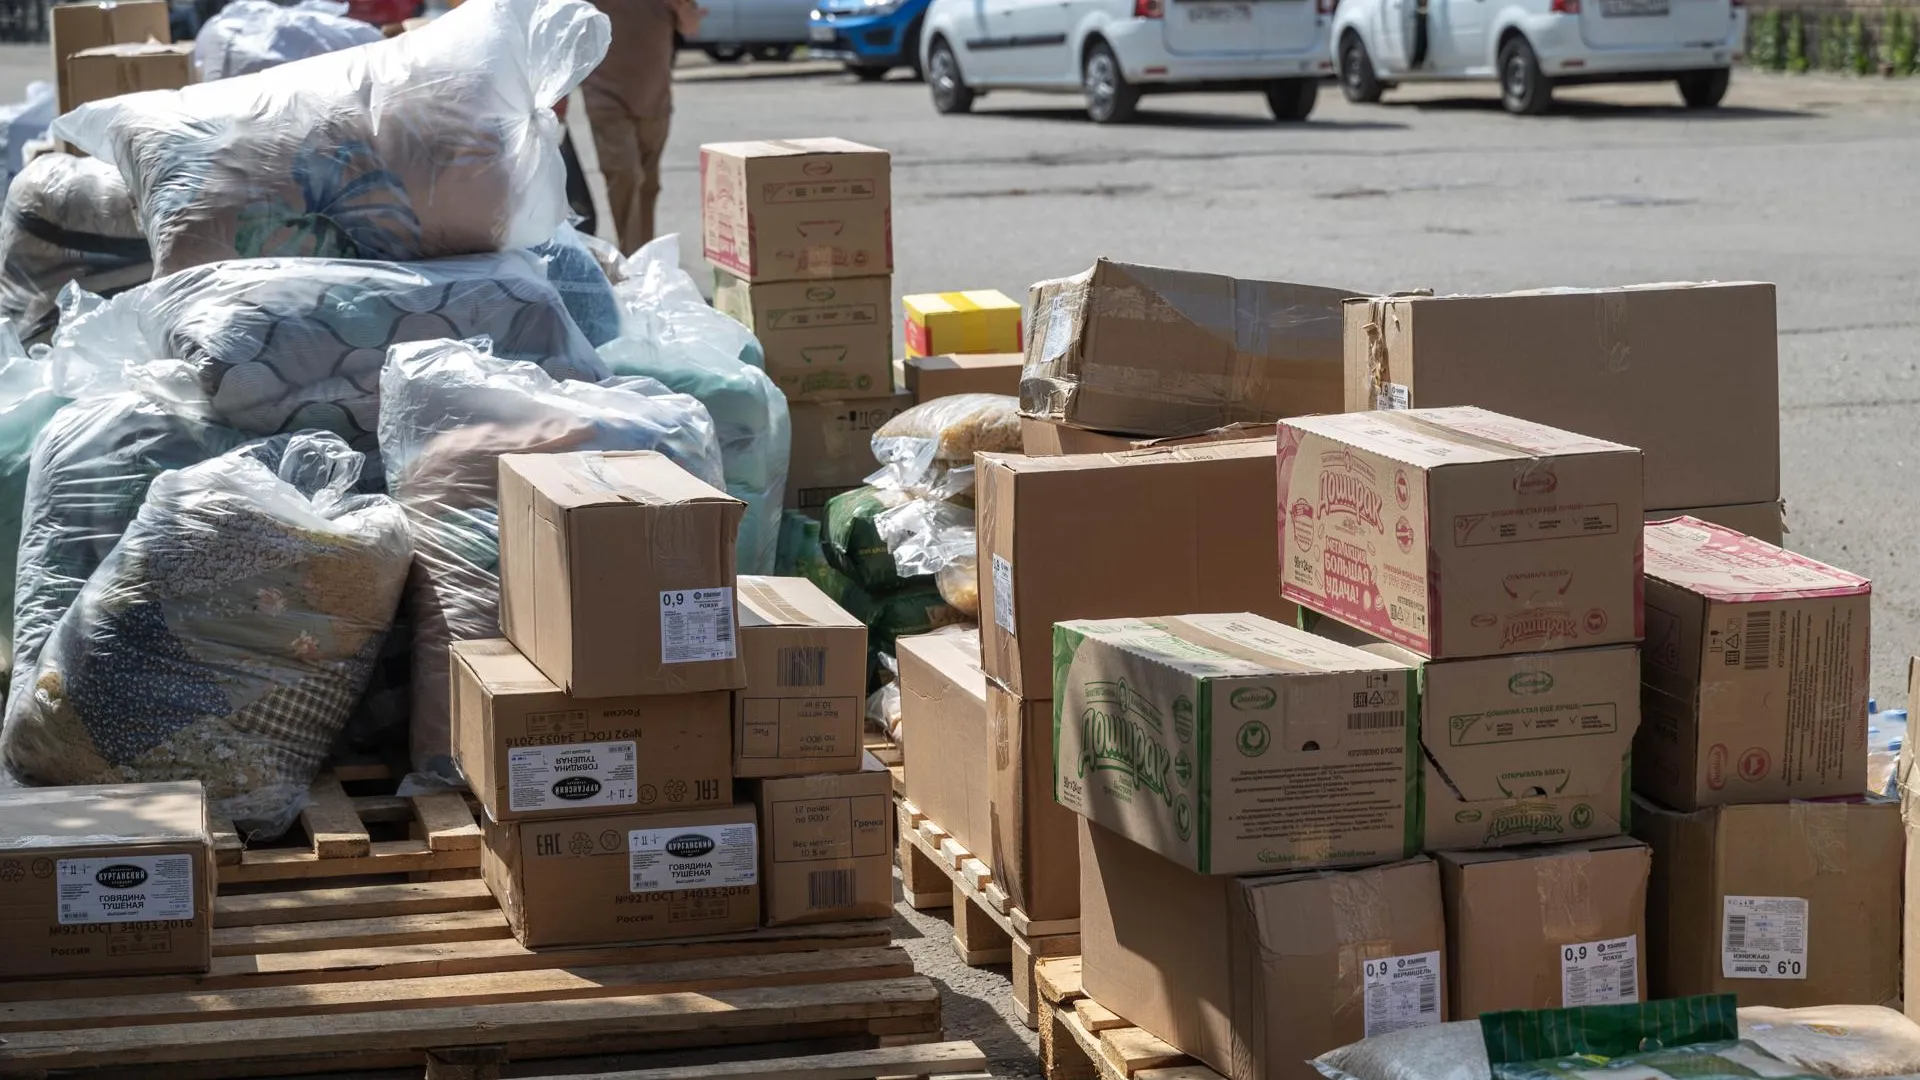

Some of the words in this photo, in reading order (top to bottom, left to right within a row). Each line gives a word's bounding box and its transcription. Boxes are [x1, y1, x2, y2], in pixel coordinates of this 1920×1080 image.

[1325, 553, 1370, 586] БОЛЬШАЯ
[1326, 581, 1359, 604] УДАЧА!
[663, 593, 684, 608] 0,9
[555, 755, 596, 764] ТУШЕНАЯ
[1078, 707, 1172, 807] Доширак
[554, 763, 599, 772] ГОВЯДИНА
[1483, 812, 1564, 844] Доширак
[668, 861, 713, 871] ГОВЯДИНА
[671, 869, 711, 878] ТУШЕНАЯ
[99, 893, 146, 903] ГОВЯДИНА
[102, 901, 144, 910] ТУШЕНАЯ
[1565, 946, 1587, 963] 0,9
[1366, 961, 1387, 978] 0,9
[1777, 958, 1801, 974] 0,9
